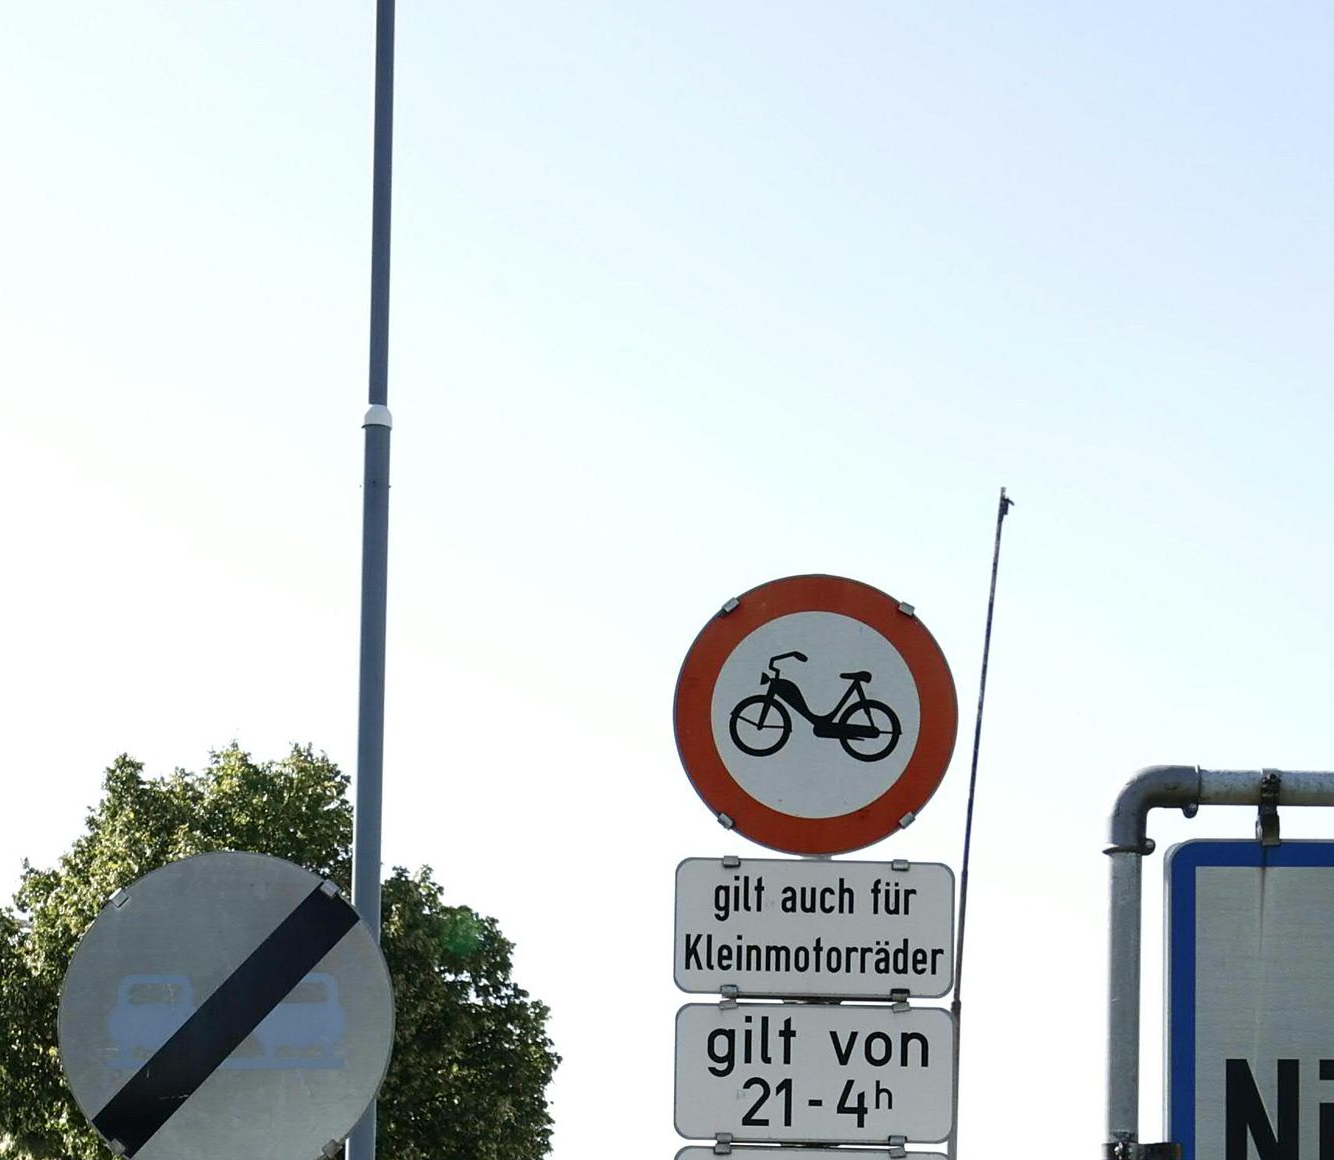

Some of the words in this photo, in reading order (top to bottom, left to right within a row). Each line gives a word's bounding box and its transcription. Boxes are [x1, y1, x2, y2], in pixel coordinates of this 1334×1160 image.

[714, 875, 765, 921] gilt
[781, 877, 855, 915] auch
[871, 878, 917, 916] für
[684, 933, 945, 976] Kleinmotorräder
[707, 1015, 797, 1077] gilt
[829, 1030, 929, 1068] von
